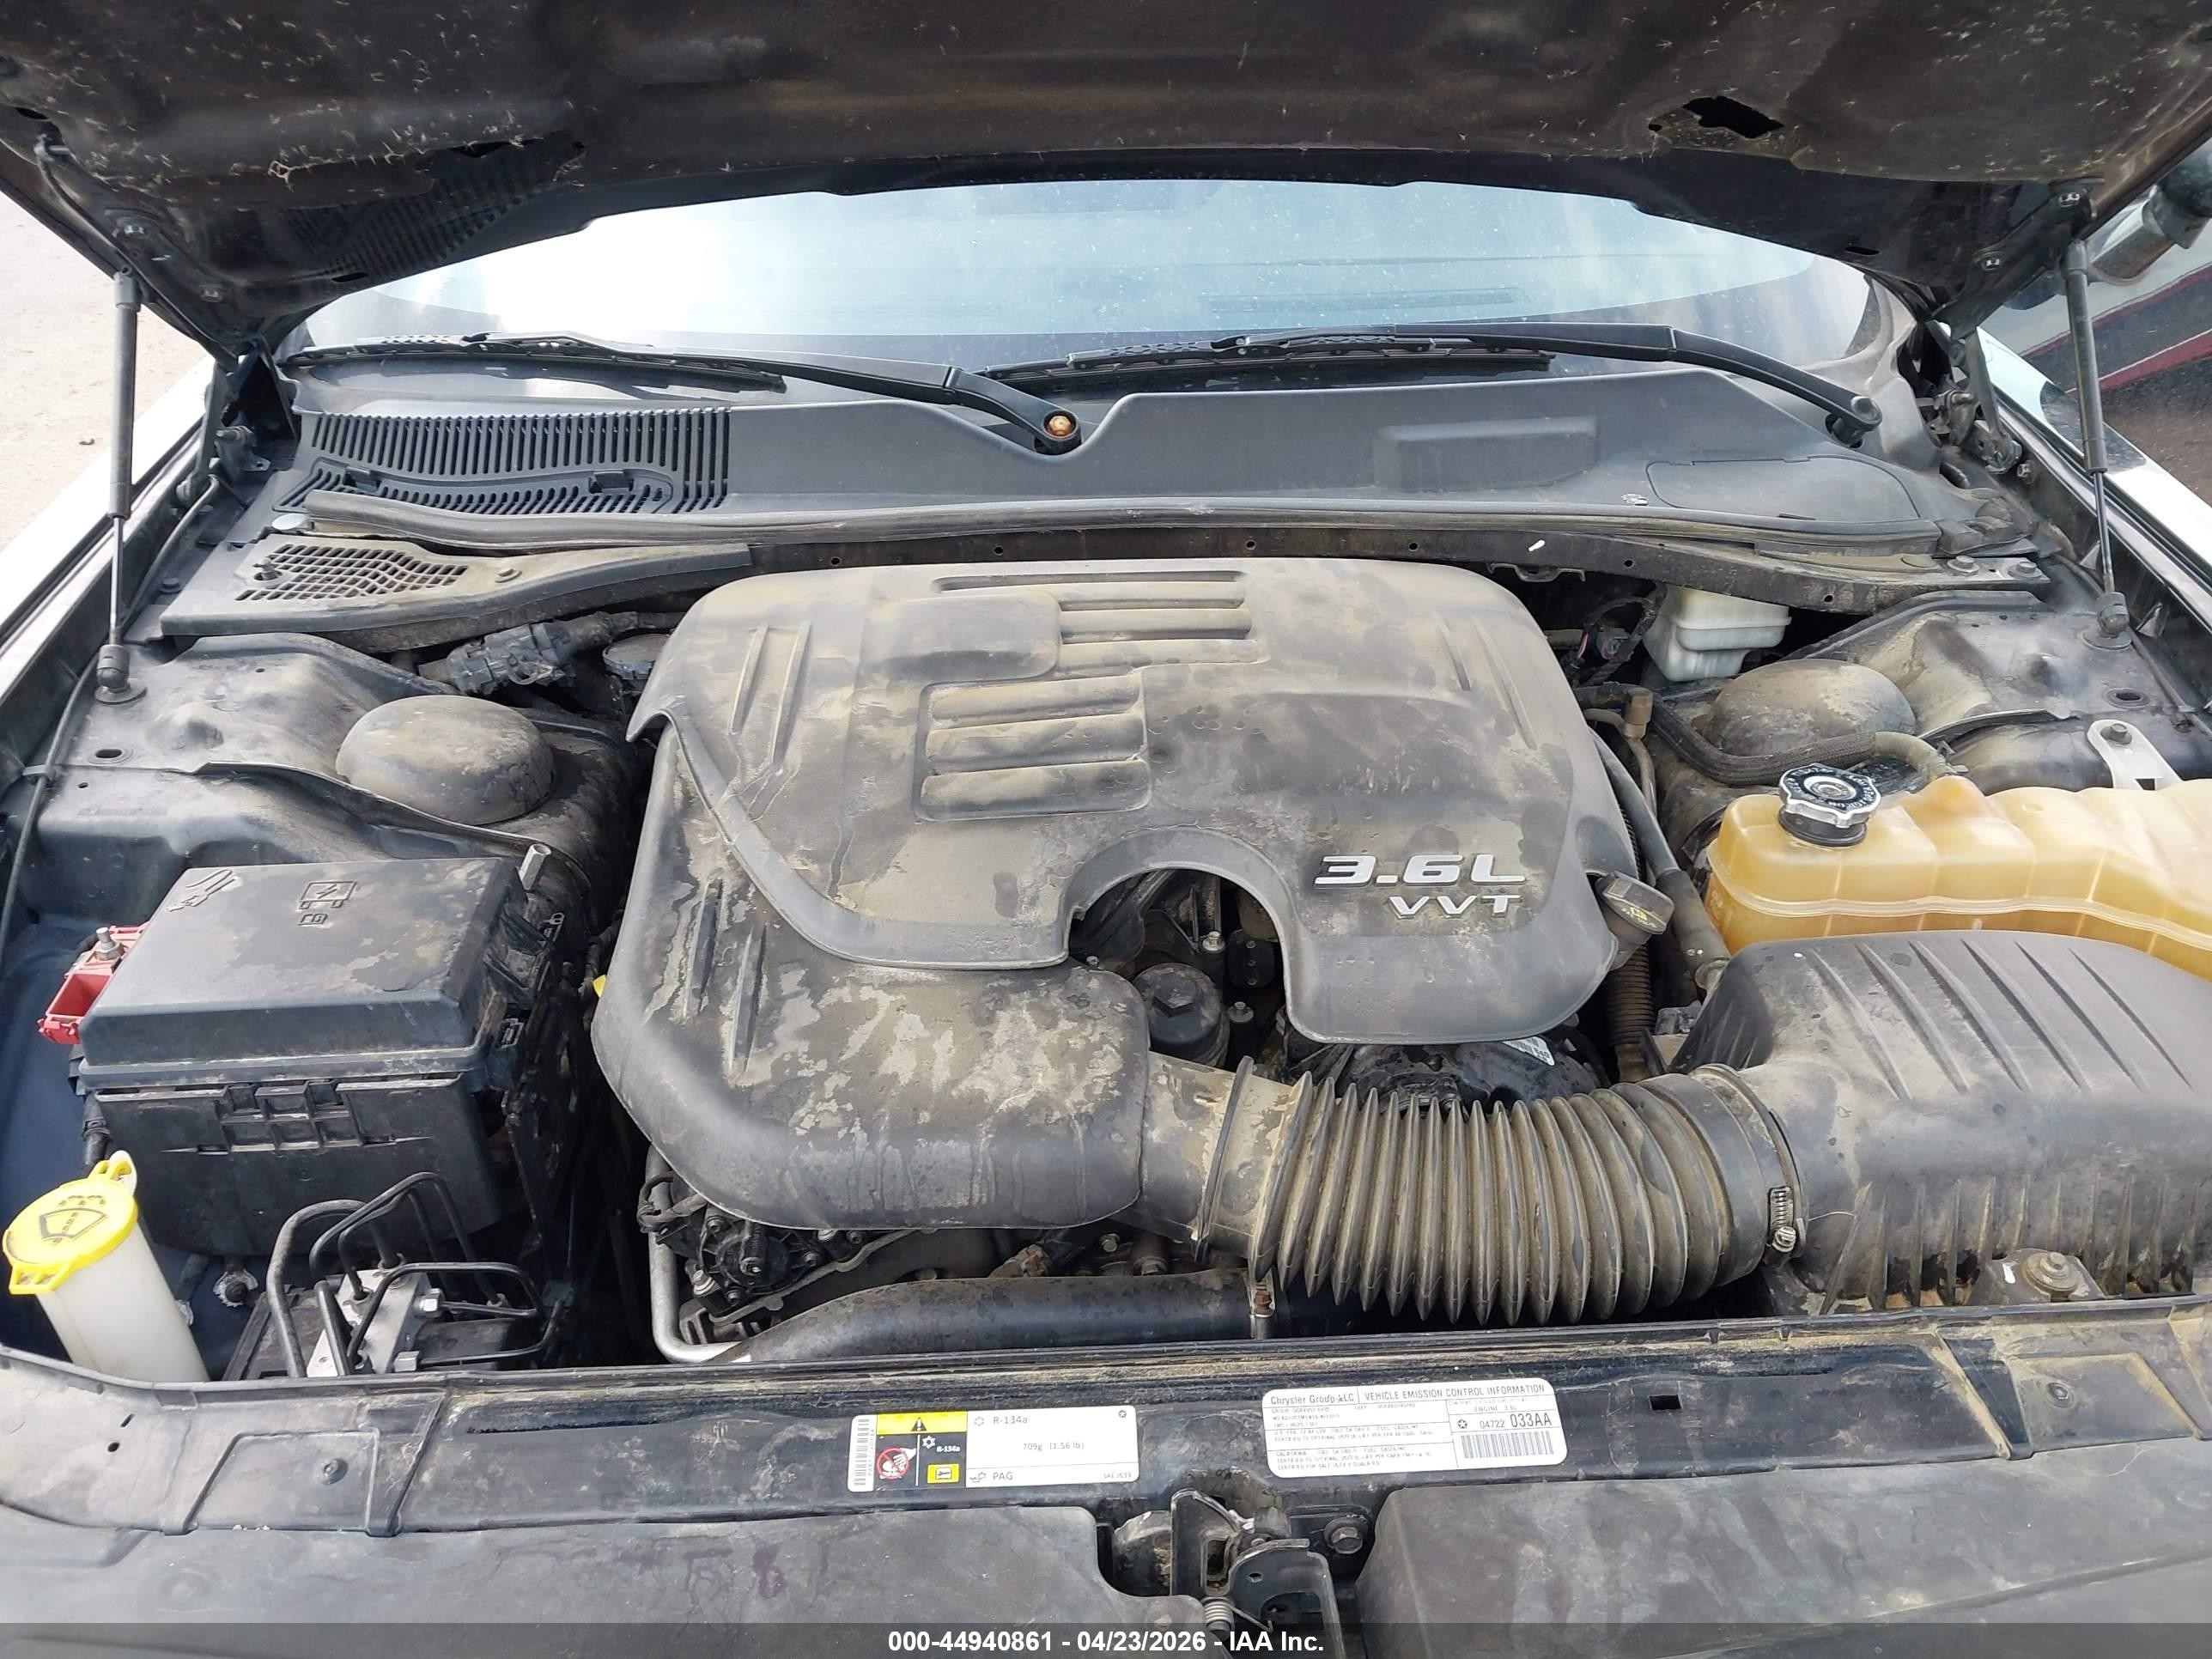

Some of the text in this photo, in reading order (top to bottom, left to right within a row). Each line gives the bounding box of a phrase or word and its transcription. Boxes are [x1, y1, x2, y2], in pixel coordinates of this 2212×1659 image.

[1315, 854, 1526, 886] 3.6L
[1389, 895, 1522, 919] VVT
[1271, 1393, 1306, 1406] Chrysler
[1364, 1383, 1545, 1401] VEHICLE EMISSION CONTROL INFORMATION
[993, 1416, 1028, 1425] R-134a
[1480, 1413, 1552, 1429] 04722 033AA
[993, 1472, 1013, 1481] PAG
